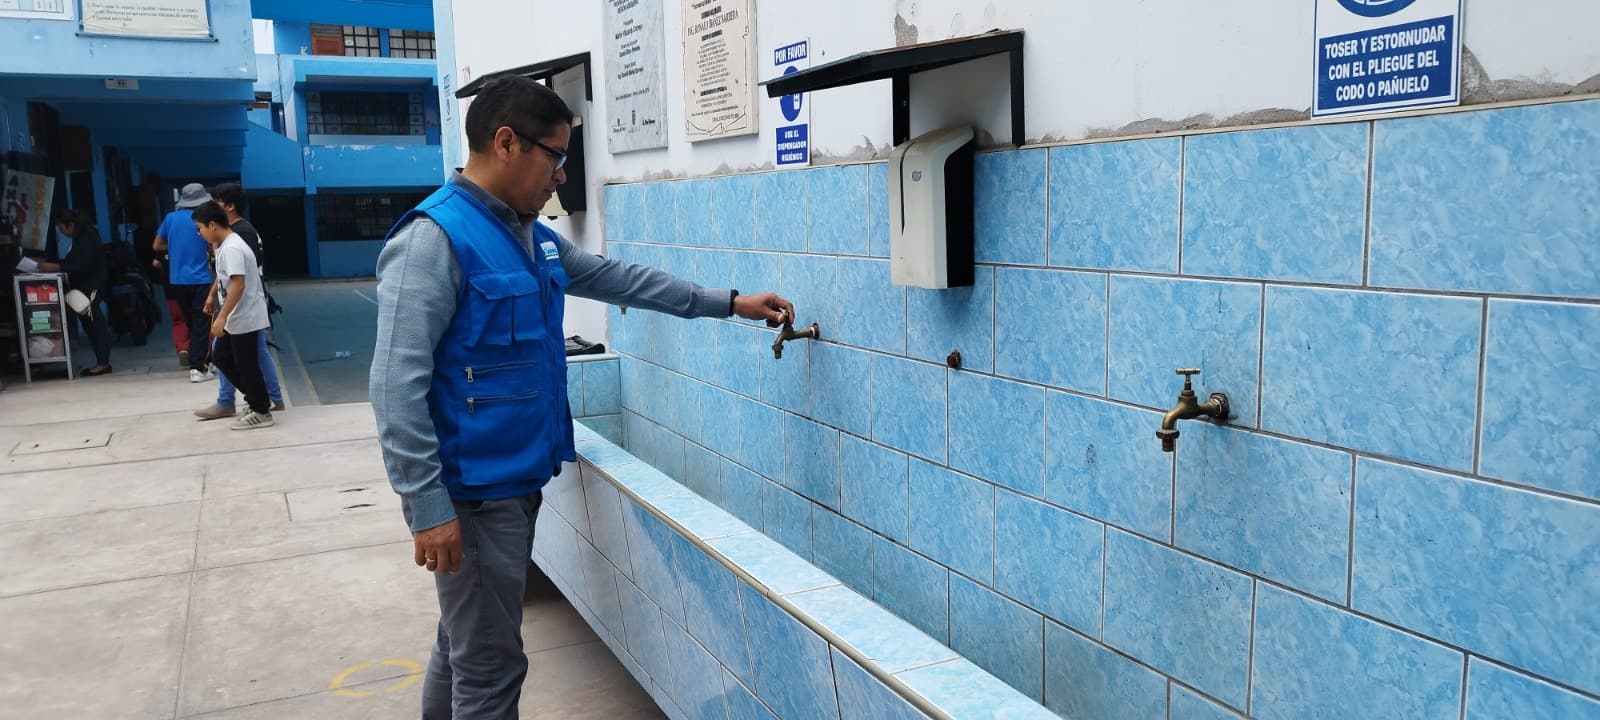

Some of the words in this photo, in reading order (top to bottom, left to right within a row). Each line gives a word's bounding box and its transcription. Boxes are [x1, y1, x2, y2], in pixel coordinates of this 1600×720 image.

[775, 49, 787, 64] POR
[787, 43, 806, 60] FAVOR
[1325, 39, 1358, 60] TOSER
[1361, 37, 1369, 54] Y
[1370, 24, 1446, 53] ESTORNUDAR
[1328, 63, 1350, 81] CON
[1352, 61, 1366, 77] EL
[1368, 53, 1415, 76] PLIEGUE
[1417, 50, 1440, 69] DEL
[1336, 83, 1365, 102] CODO
[1367, 82, 1375, 98] O
[1378, 74, 1430, 97] PAÑUELO
